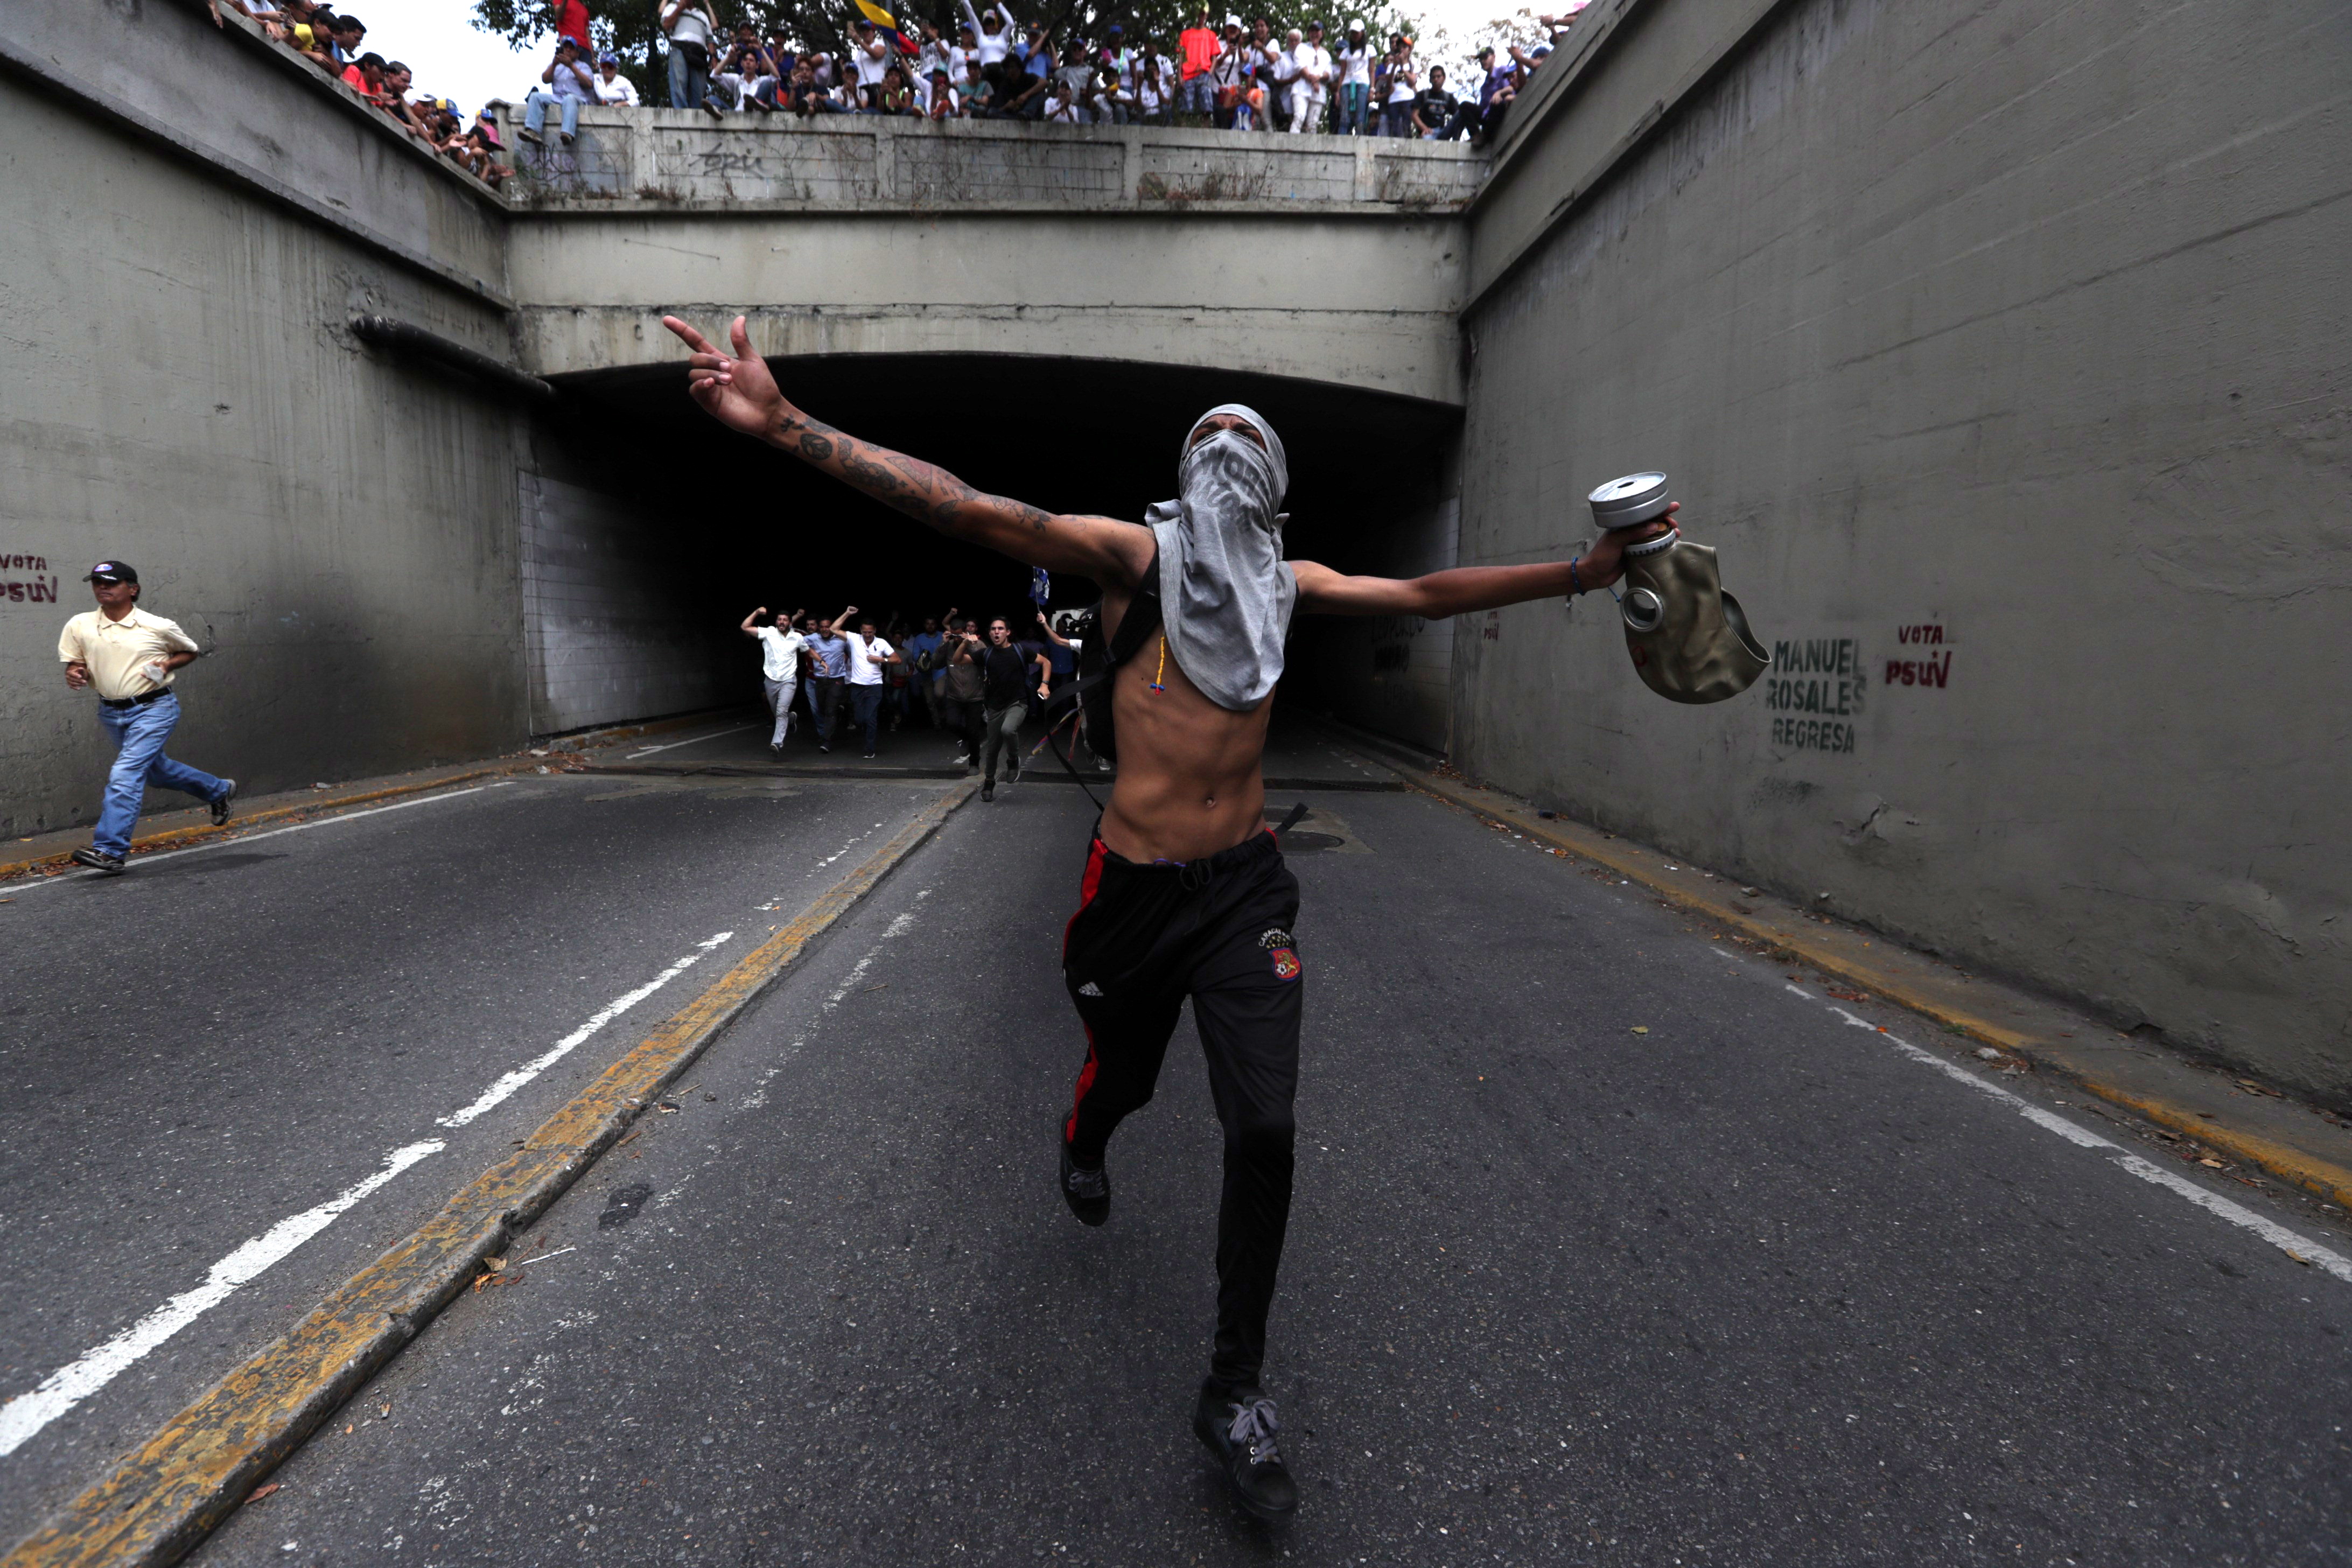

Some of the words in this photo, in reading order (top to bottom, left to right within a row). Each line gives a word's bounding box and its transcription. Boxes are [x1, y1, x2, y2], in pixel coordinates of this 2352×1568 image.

[0, 554, 47, 571] VOTA
[1899, 625, 1943, 644] VOTA
[1774, 639, 1866, 678] MANUEL
[1766, 677, 1867, 716] ROSALES
[1772, 718, 1854, 754] REGRESA
[1258, 928, 1282, 947] CARACAS
